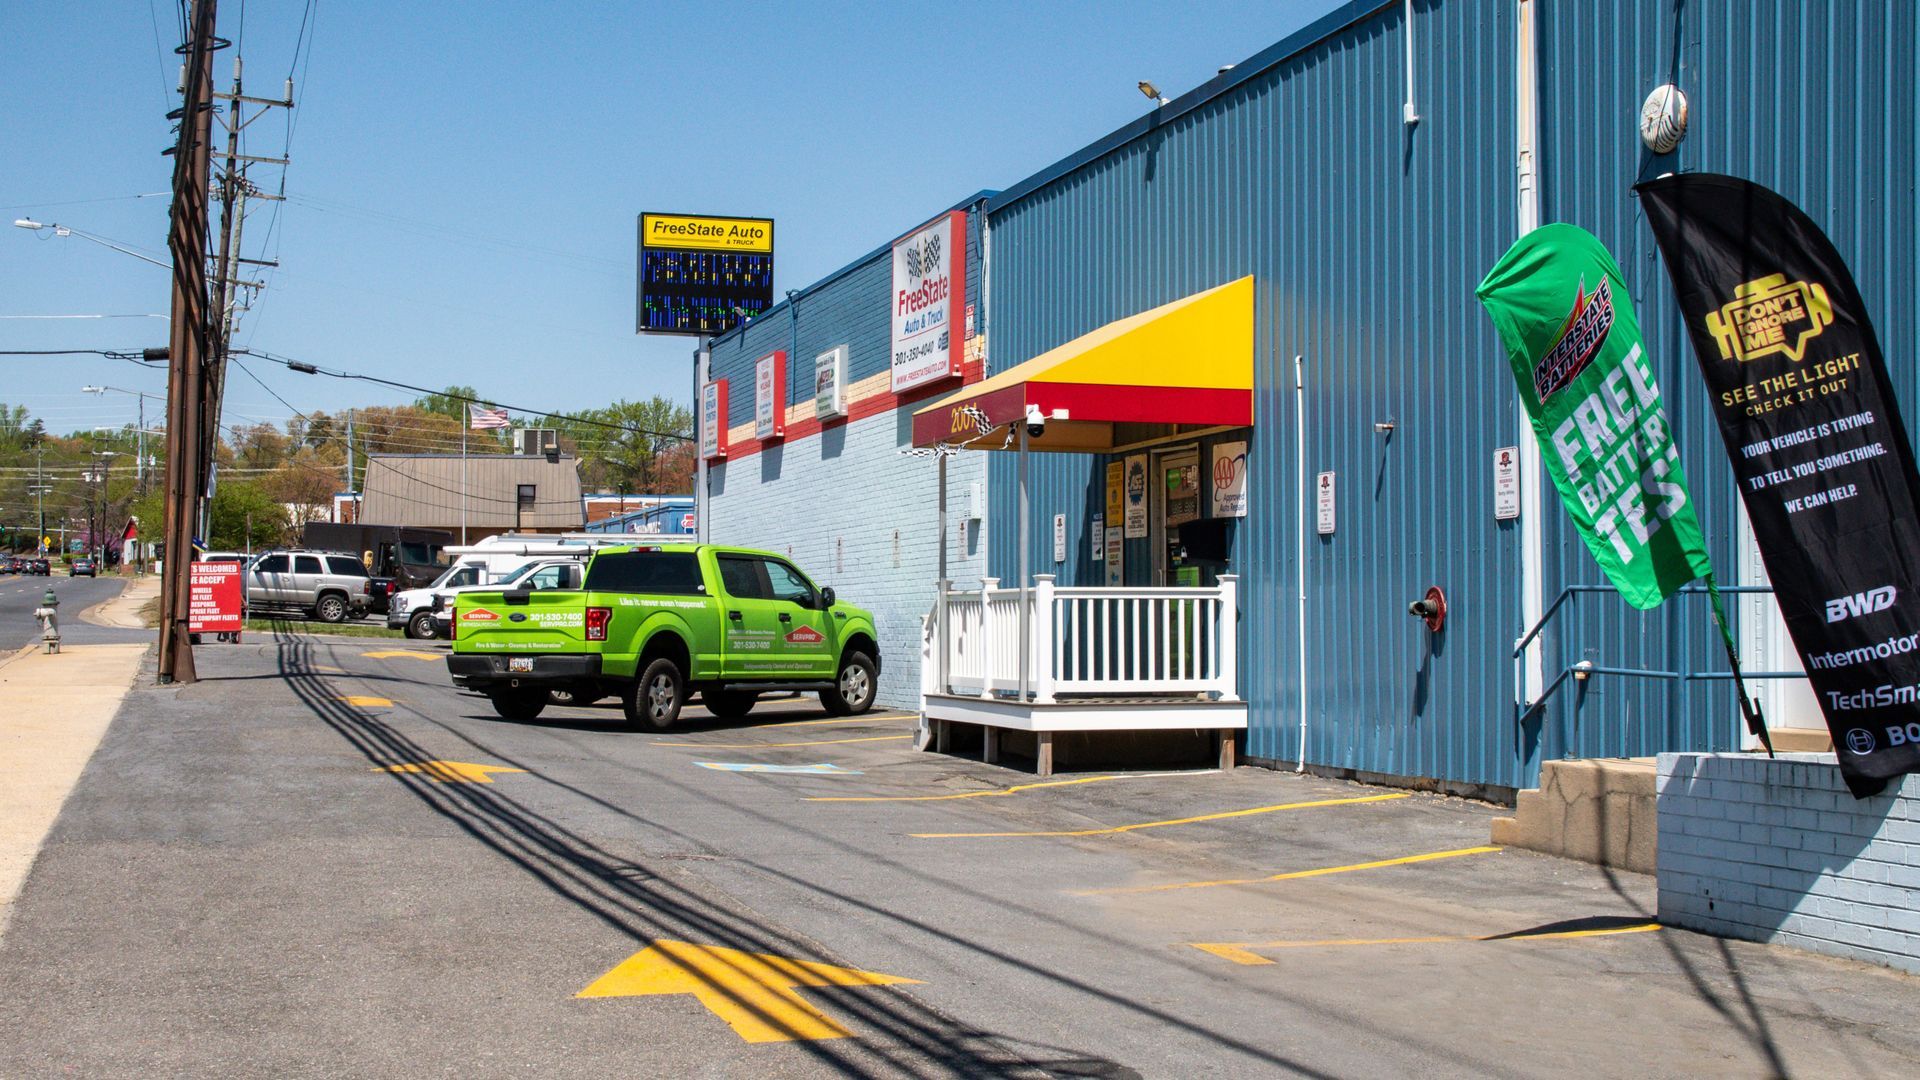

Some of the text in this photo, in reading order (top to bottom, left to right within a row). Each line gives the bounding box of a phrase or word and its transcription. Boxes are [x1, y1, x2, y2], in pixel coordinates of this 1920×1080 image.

[653, 221, 764, 239] FreeState Auto
[898, 274, 948, 317] FreeState
[1733, 291, 1800, 324] DON'T
[904, 316, 920, 335] Auto
[921, 315, 926, 328] &
[928, 309, 944, 328] Truck
[1534, 282, 1609, 385] INTERSTATE
[1738, 306, 1806, 336] IGNORE
[1540, 304, 1613, 398] BATTERIES
[1743, 325, 1786, 351] ME
[1722, 353, 1860, 407] SEE THE LIGHT
[1746, 378, 1848, 416] CHECK IT OUT
[1551, 342, 1660, 484] FREE
[1741, 411, 1875, 459] YOUR VEHICLE IS TRYING
[1750, 442, 1888, 490] TO TELL YOU SOMETHING.
[1219, 503, 1245, 512] Auto Repair
[1223, 492, 1245, 502] Approved
[1784, 484, 1858, 514] WE CAN HELP.
[199, 565, 237, 573] WELCOMED
[199, 576, 225, 584] ACCEPT
[530, 613, 583, 621] 301-530-7400
[1825, 585, 1897, 624] BWD
[733, 641, 771, 649] 301-530-7400
[793, 633, 816, 641] SERVPRO
[1808, 633, 1920, 670] Intermotor
